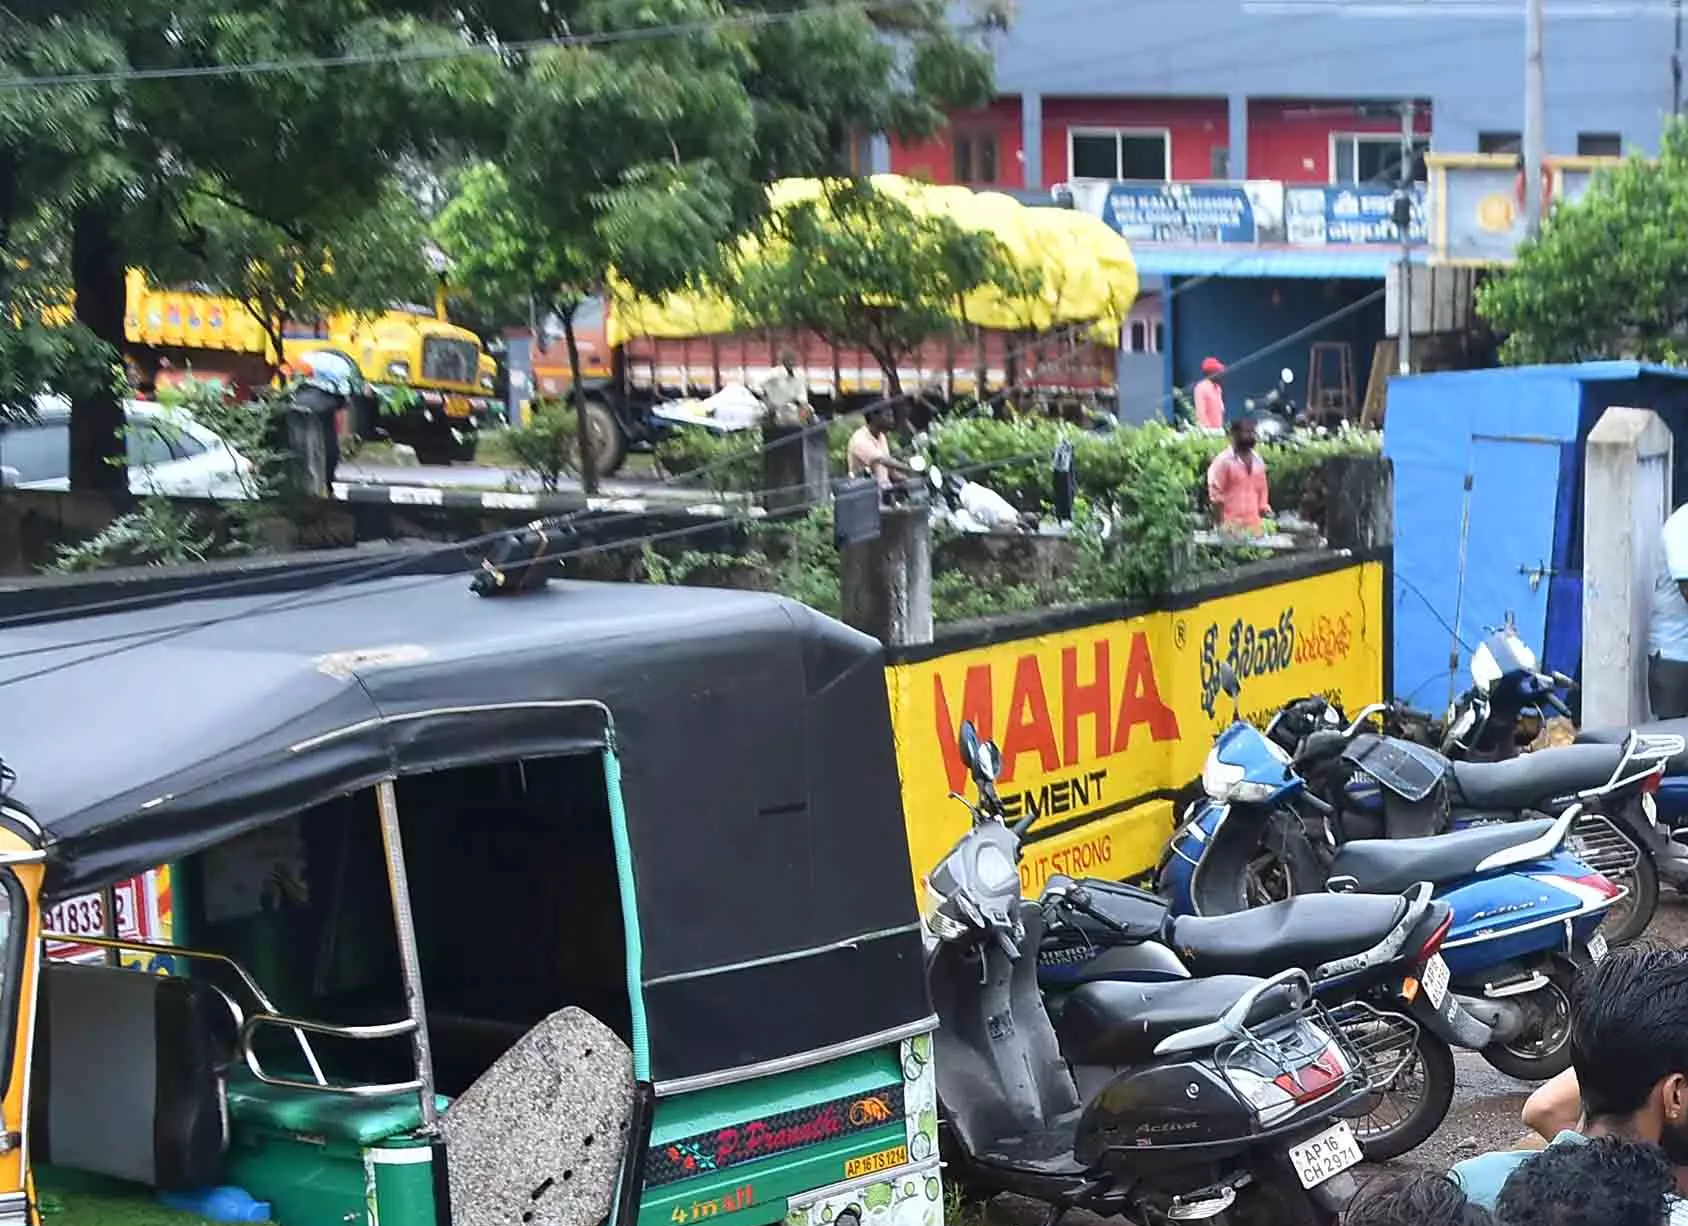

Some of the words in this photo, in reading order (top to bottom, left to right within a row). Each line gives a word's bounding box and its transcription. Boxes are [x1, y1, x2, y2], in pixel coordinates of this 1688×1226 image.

[933, 631, 1182, 796] MAHA
[1000, 770, 1107, 830] EMENT
[1052, 834, 1112, 877] STRONG
[847, 1161, 860, 1177] AP
[863, 1156, 872, 1172] 16
[872, 1153, 885, 1169] TS
[886, 1146, 905, 1166] 1214
[1303, 1163, 1325, 1182] CH
[1324, 1146, 1356, 1173] 2971
[1304, 1143, 1322, 1165] AP
[1324, 1136, 1339, 1152] 16
[671, 1204, 688, 1224] 4
[690, 1199, 718, 1219] in
[722, 1183, 753, 1213] all
